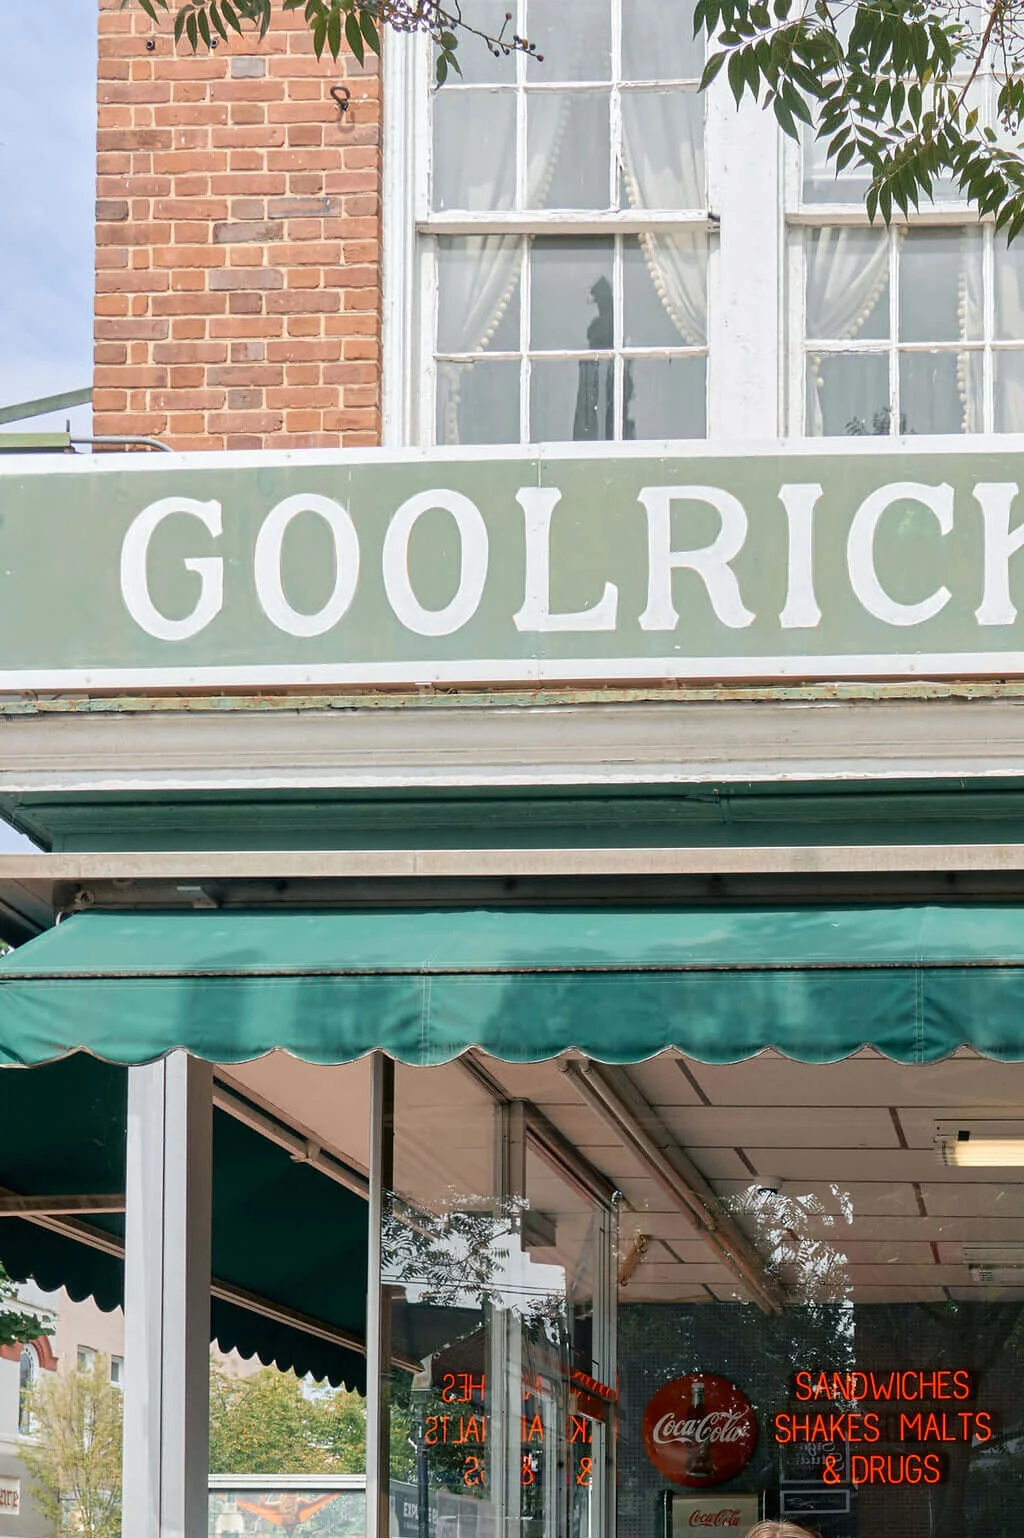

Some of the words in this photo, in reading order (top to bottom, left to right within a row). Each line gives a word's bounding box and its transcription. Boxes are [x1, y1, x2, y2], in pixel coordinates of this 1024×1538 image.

[795, 1370, 970, 1401] SANDWICHES
[774, 1412, 881, 1444] SHAKES
[899, 1411, 993, 1442] MALTS
[821, 1454, 841, 1485] &
[851, 1453, 941, 1485] DRUGS
